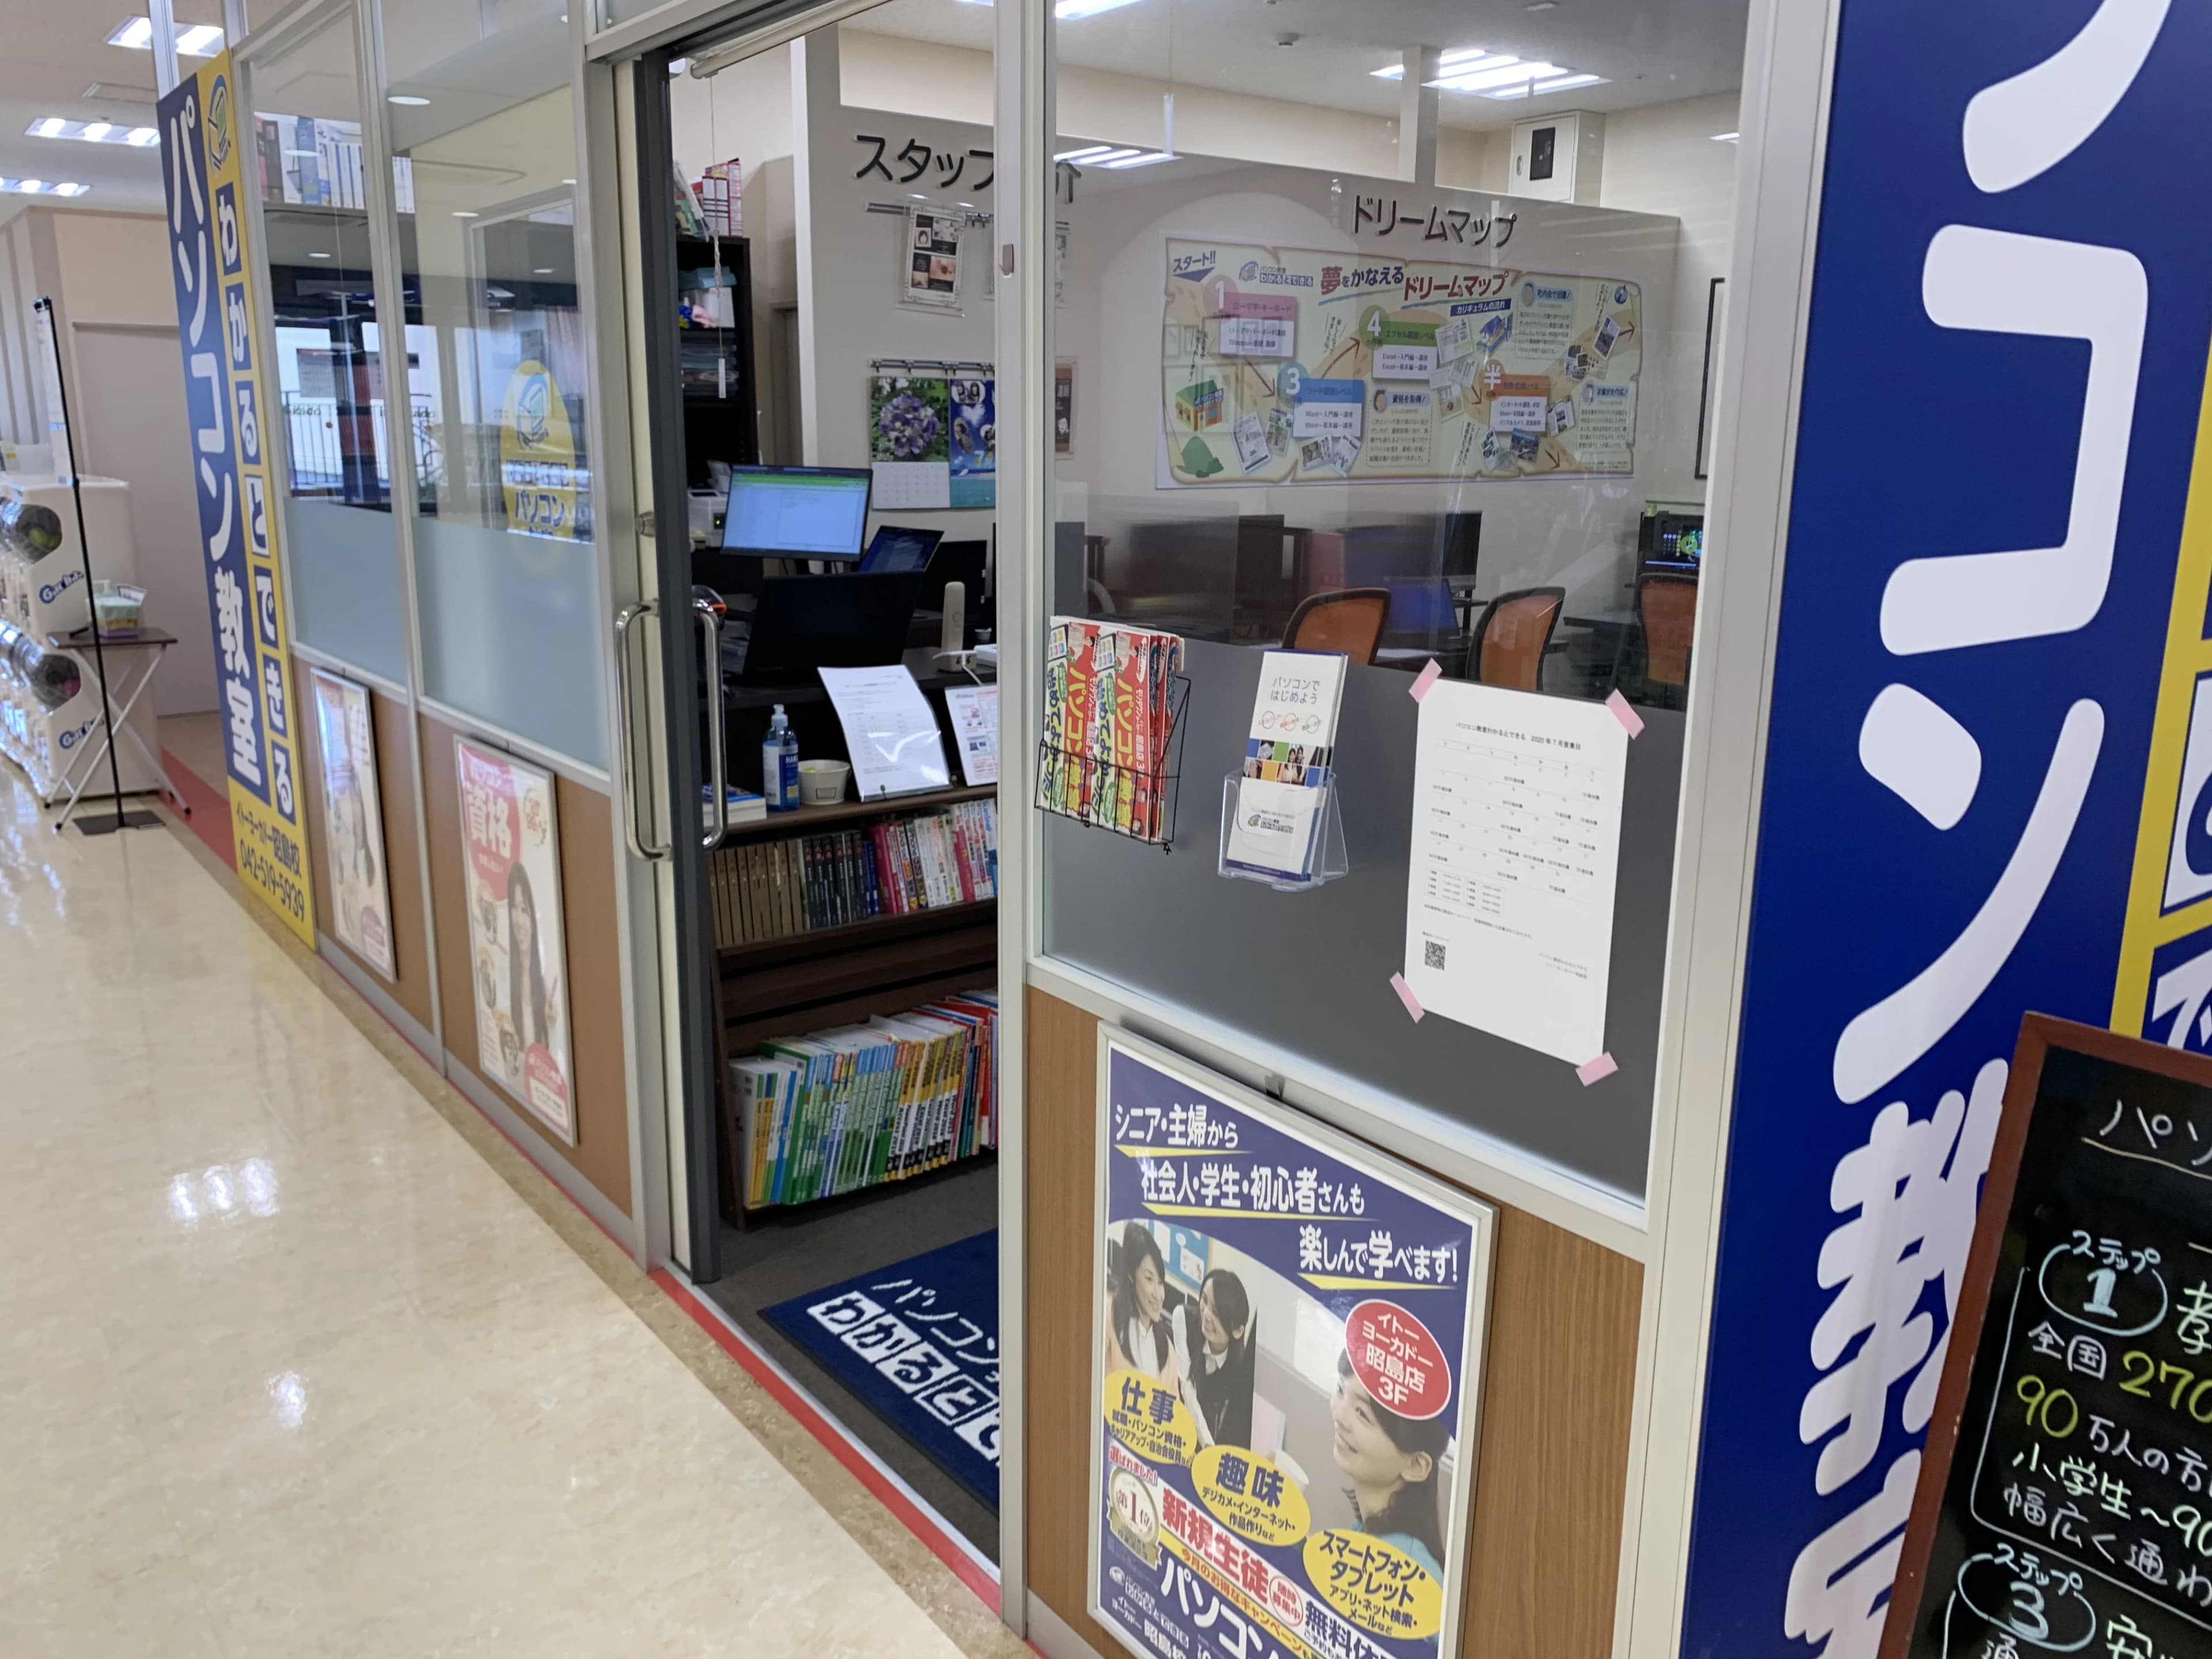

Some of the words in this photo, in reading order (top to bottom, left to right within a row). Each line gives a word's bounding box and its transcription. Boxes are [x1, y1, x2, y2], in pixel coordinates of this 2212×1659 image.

[1354, 195, 1517, 248] ドリームマップ
[1214, 281, 1225, 309] 1
[1259, 272, 1314, 287] わかるとできる
[1320, 265, 1405, 296] 夢をかなえる
[1403, 271, 1510, 301] ドリームマップ
[1367, 310, 1381, 337] 4
[1456, 300, 1506, 315] カリキュラムの流れ
[1286, 367, 1301, 395] 3
[171, 94, 263, 787] パソコン教室
[218, 193, 294, 816] わかるとできる
[515, 489, 566, 528] パソコン
[1270, 690, 1318, 705] はじめよう
[1272, 675, 1321, 692] パソコンで
[465, 780, 512, 859] 資格
[240, 838, 305, 923] 042-519-5939
[1114, 1103, 1239, 1149] シニア・主婦から
[1141, 1159, 1365, 1215] 社会人・学生・初心者さんも
[1299, 1224, 1459, 1284] 楽しんで学べます!
[2072, 1230, 2162, 1274] ステップ
[2083, 1267, 2119, 1319] 1
[1362, 1320, 1433, 1368] ヨーカドー
[1377, 1312, 1420, 1341] イトー
[1366, 1343, 1426, 1395] 昭島店
[2028, 1320, 2107, 1381] 全国
[1120, 1377, 1177, 1426] 仕事
[1377, 1376, 1410, 1406] 3F
[2016, 1374, 2079, 1438] 90
[1215, 1452, 1285, 1509] 趣味
[1161, 1487, 1270, 1606] 新規生徒
[1228, 1511, 1276, 1543] 作品作りなど
[1330, 1562, 1414, 1608] タブレット
[1993, 1541, 2084, 1596] ステップ
[1348, 1607, 1393, 1636] メールなど
[2008, 1581, 2050, 1641] 3
